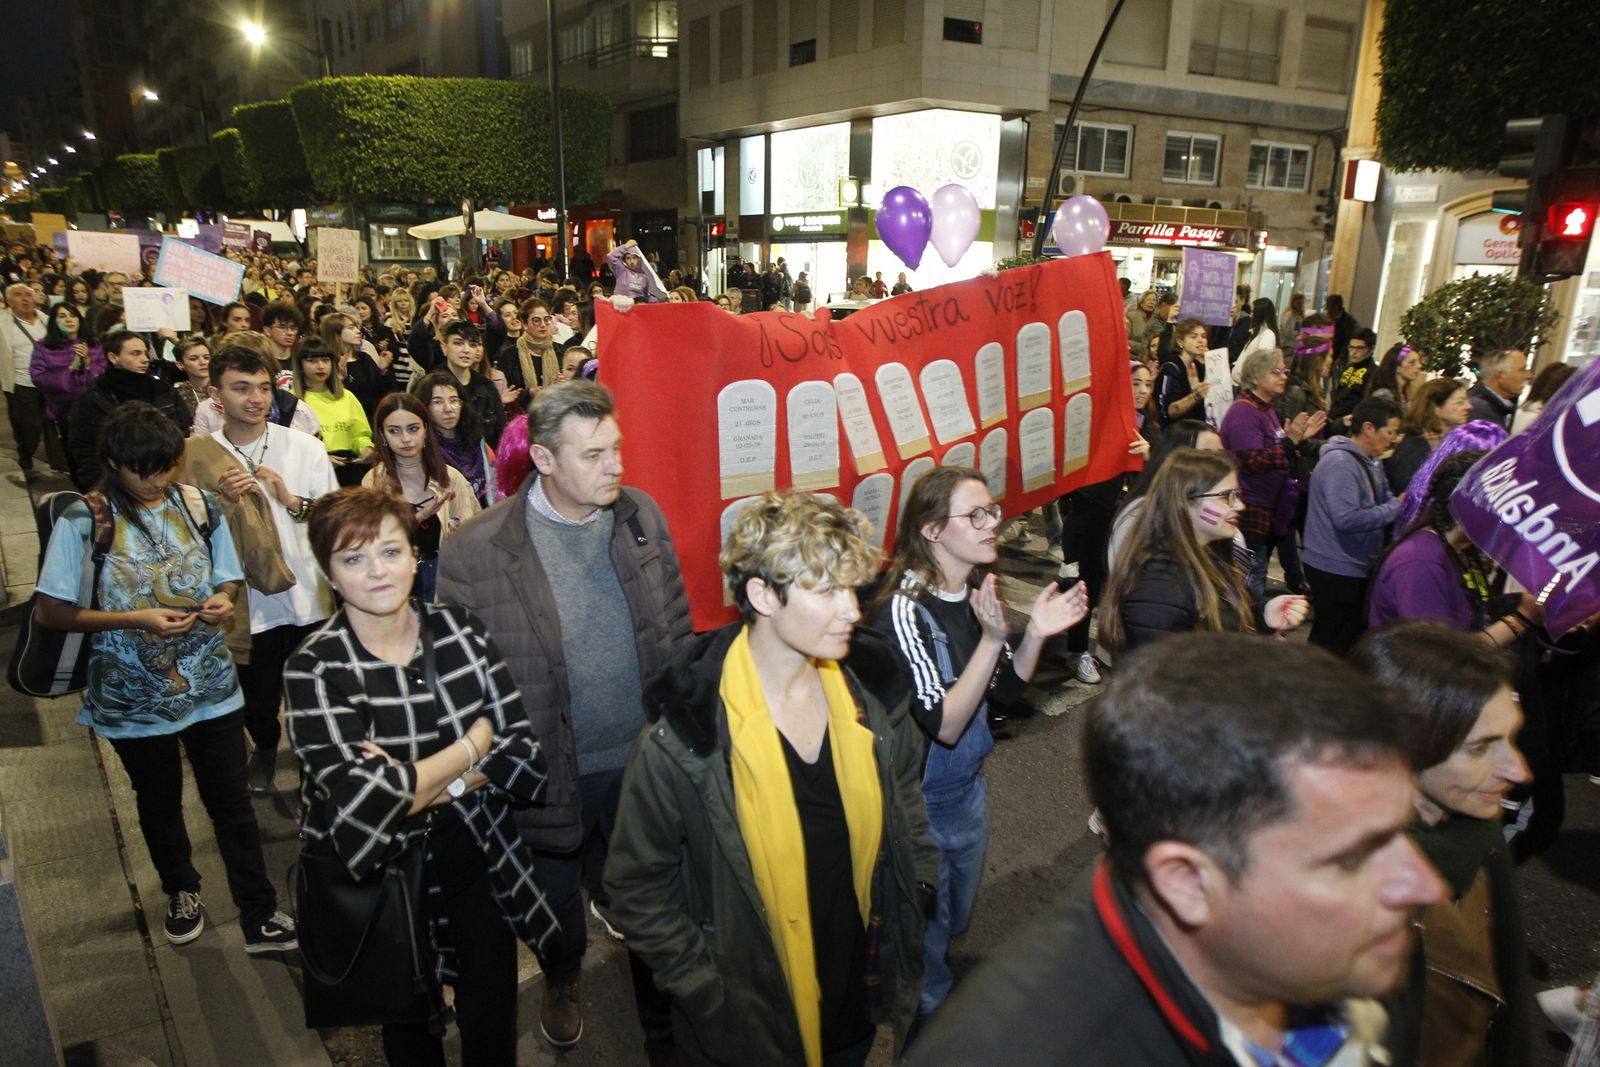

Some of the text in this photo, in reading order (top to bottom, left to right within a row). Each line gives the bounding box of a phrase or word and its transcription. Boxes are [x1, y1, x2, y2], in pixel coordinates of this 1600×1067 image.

[1118, 222, 1225, 241] Parrilla Pasaje
[1484, 239, 1520, 248] Gene
[1485, 249, 1521, 260] Optic
[855, 297, 970, 345] vuestra
[729, 404, 767, 413] CONTRERAS
[745, 419, 761, 427] AÑOS
[733, 434, 763, 442] GRANADA
